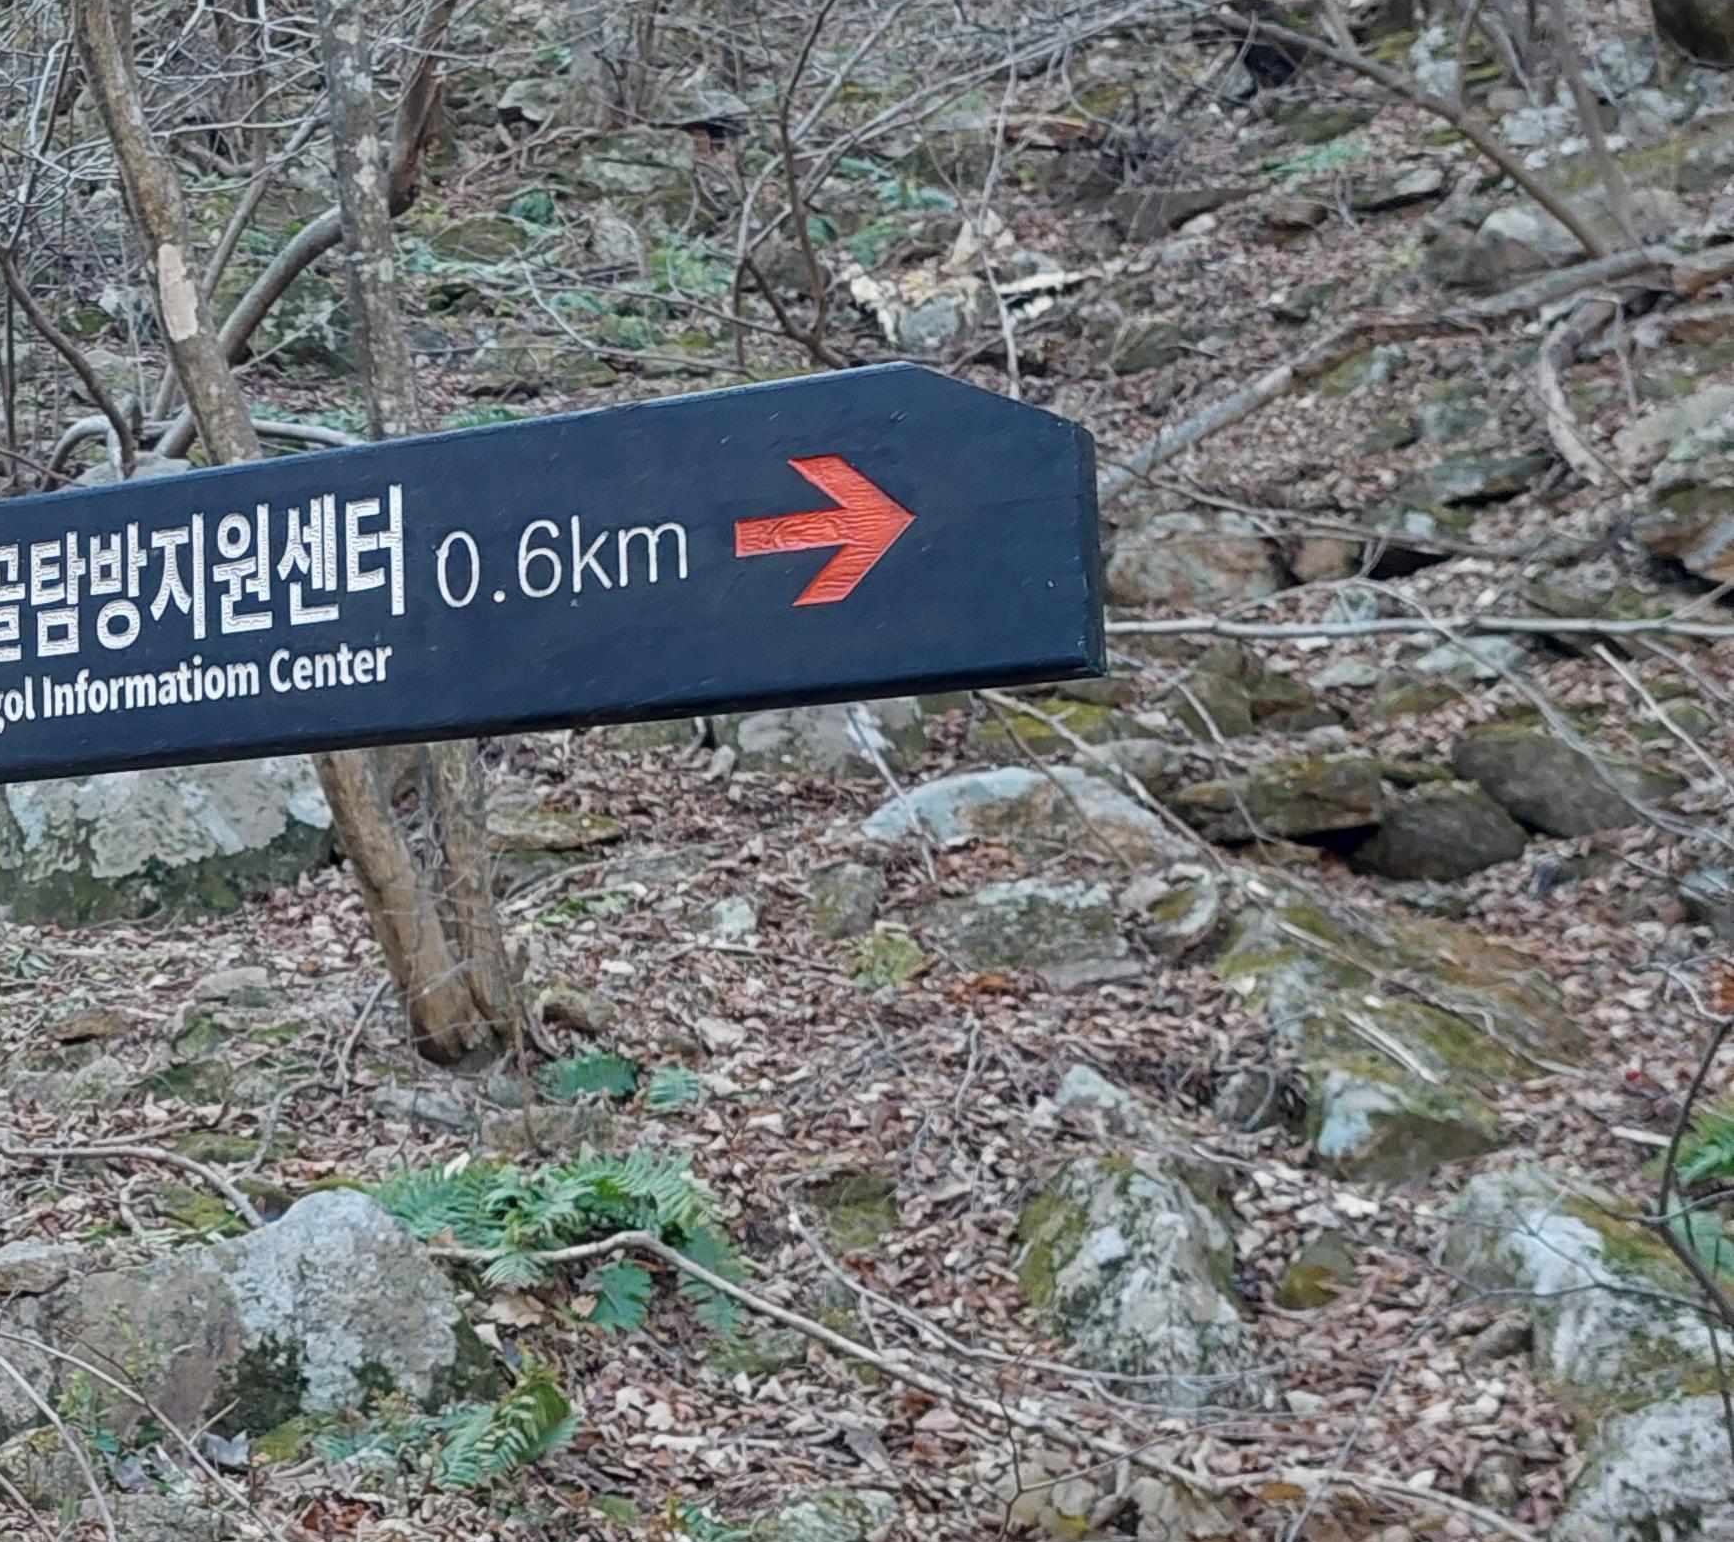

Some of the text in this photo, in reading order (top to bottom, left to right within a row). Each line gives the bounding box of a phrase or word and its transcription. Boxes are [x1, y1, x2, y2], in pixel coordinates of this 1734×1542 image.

[435, 513, 690, 610] 0.6km
[42, 653, 261, 719] Informatiom
[269, 642, 393, 694] Center
